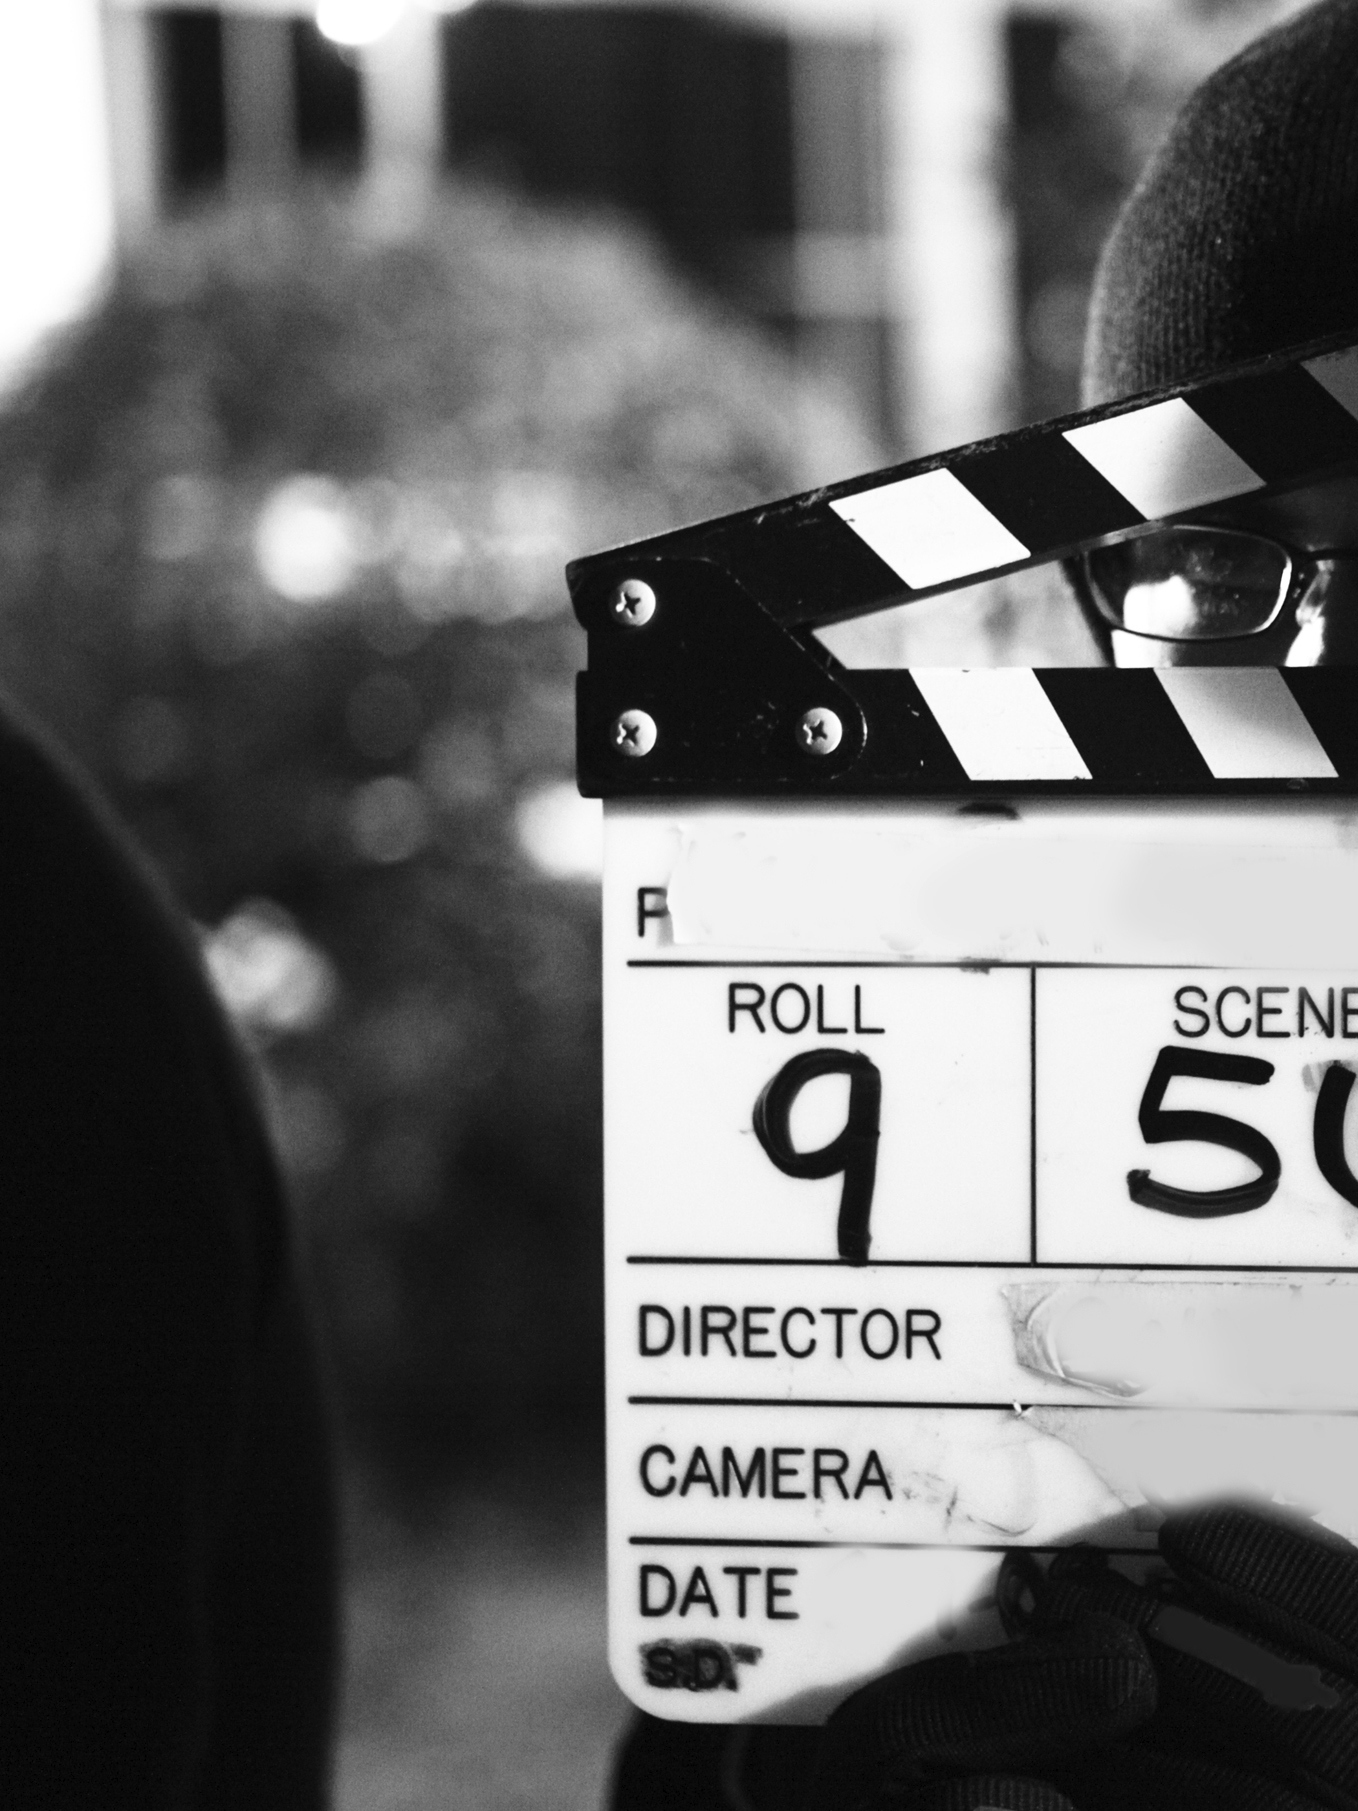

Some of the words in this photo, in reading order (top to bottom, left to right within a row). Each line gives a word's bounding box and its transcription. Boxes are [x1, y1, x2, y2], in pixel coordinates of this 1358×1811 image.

[728, 982, 885, 1034] ROLL
[751, 1048, 881, 1266] 9
[638, 1305, 942, 1360] DIRECTOR
[639, 1444, 893, 1501] CAMERA
[638, 1564, 800, 1621] DATE
